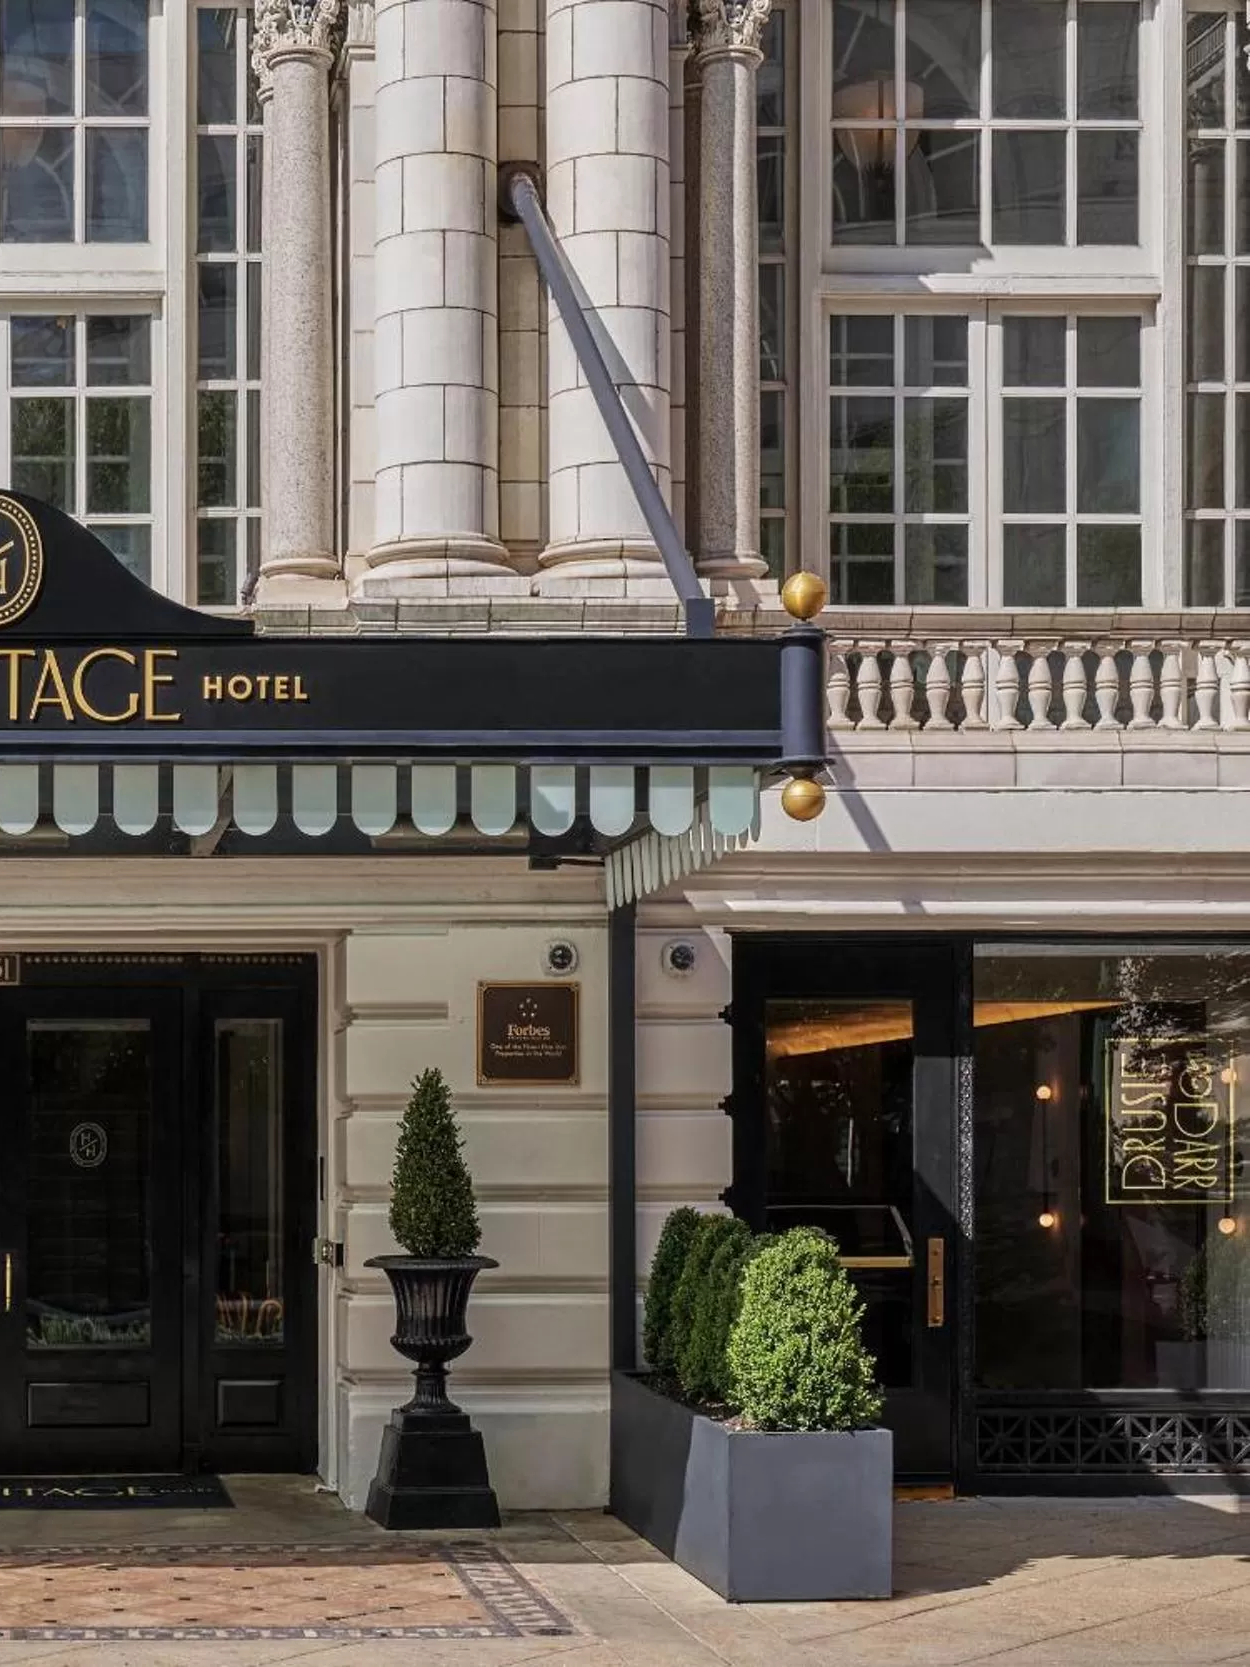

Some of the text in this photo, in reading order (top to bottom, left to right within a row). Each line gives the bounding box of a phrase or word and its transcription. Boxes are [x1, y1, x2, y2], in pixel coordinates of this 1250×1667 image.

[203, 675, 309, 701] HOTEL
[507, 1023, 551, 1036] Forbes
[1121, 1053, 1166, 1190] DRUSIE
[1172, 1102, 1221, 1191] DARR
